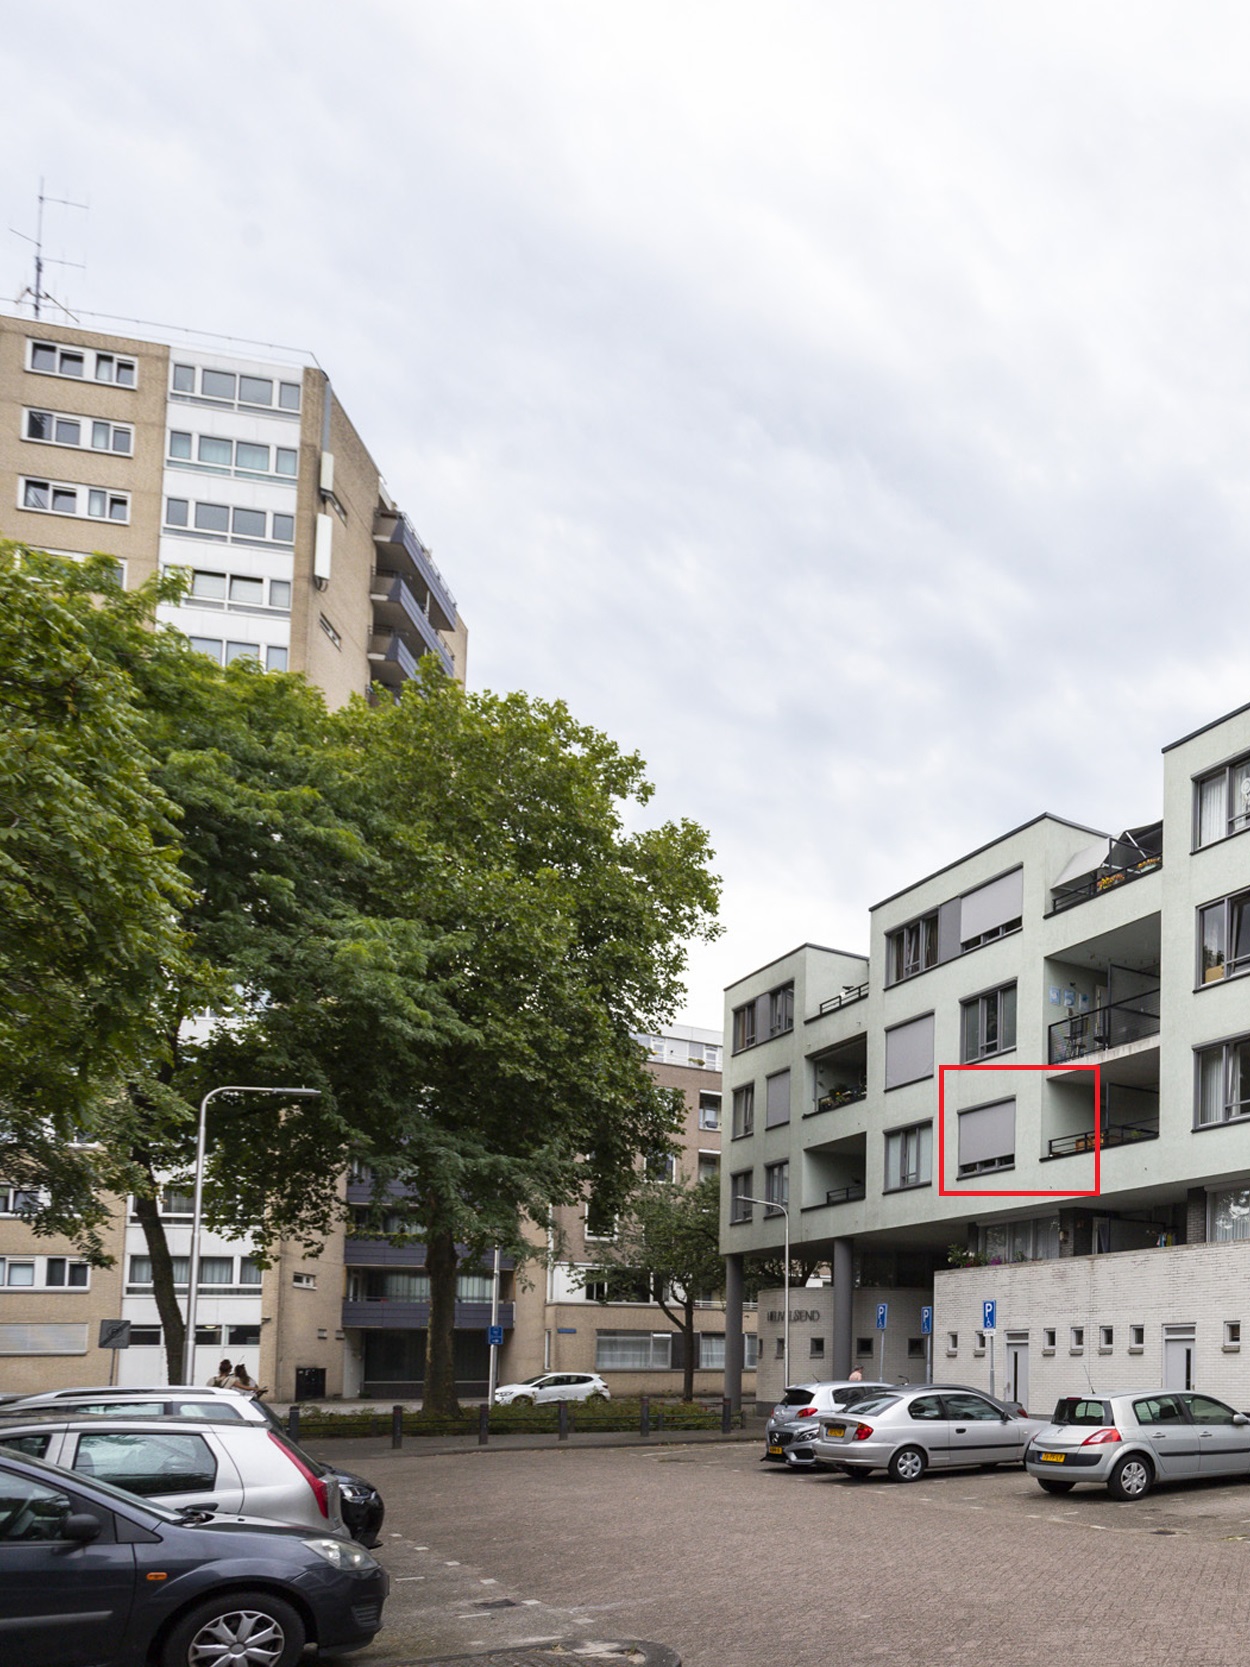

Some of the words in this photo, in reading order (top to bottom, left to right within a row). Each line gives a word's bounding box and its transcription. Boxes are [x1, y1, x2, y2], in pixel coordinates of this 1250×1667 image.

[878, 1306, 885, 1320] P
[923, 1309, 929, 1322] P
[985, 1303, 993, 1318] P
